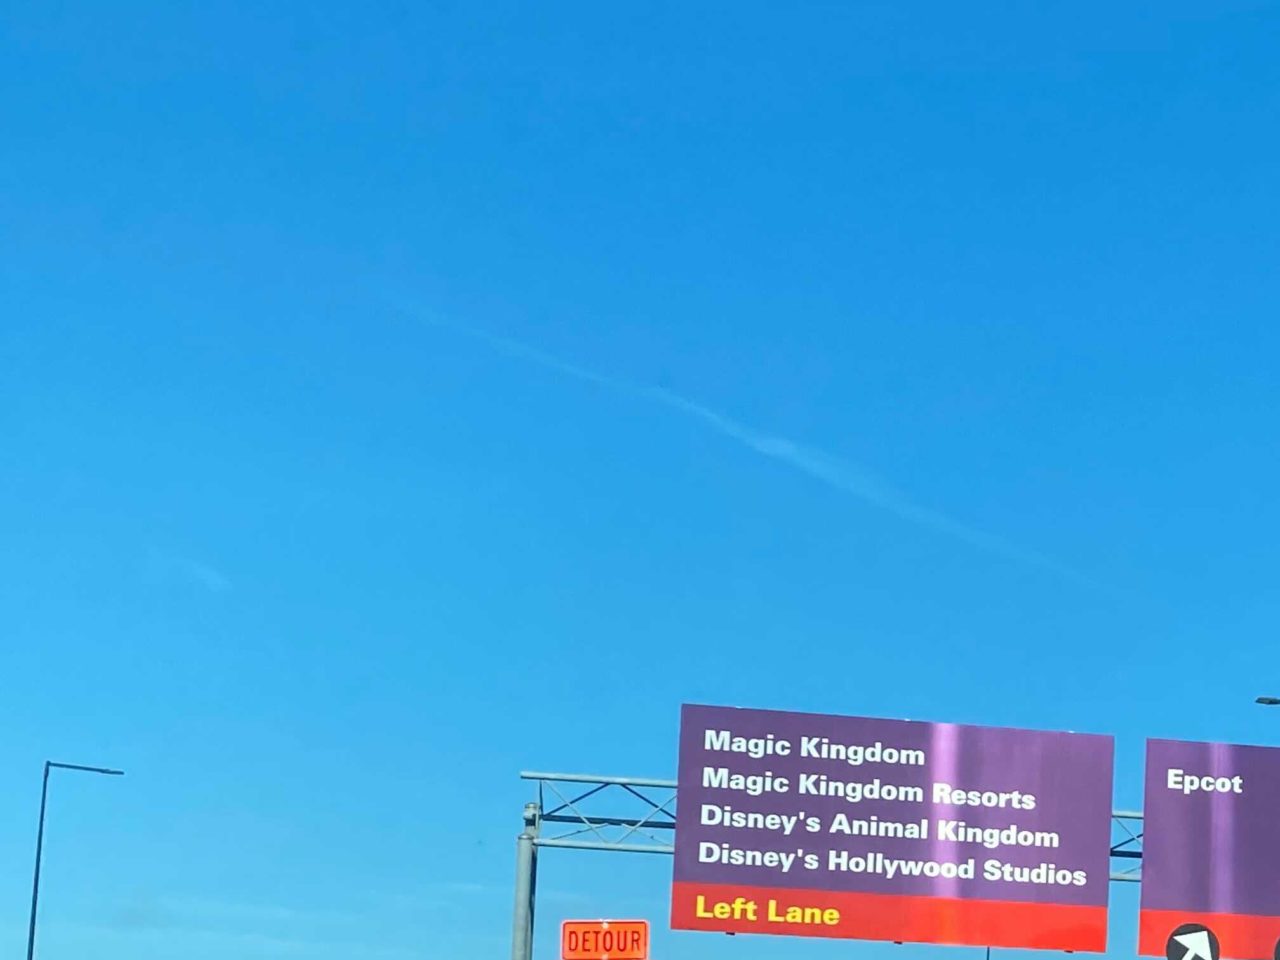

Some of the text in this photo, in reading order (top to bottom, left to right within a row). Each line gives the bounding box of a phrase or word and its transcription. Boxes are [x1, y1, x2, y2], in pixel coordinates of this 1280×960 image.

[703, 729, 925, 766] Magic Kingdom
[702, 767, 1036, 810] Magic Kingdom Resorts
[1167, 768, 1244, 795] Epcot
[700, 804, 1059, 849] Disney's Animal Kingdom
[698, 842, 1087, 886] Disney's Hollywood Studios
[695, 895, 840, 926] Left Lane
[568, 930, 641, 952] DETOUR
